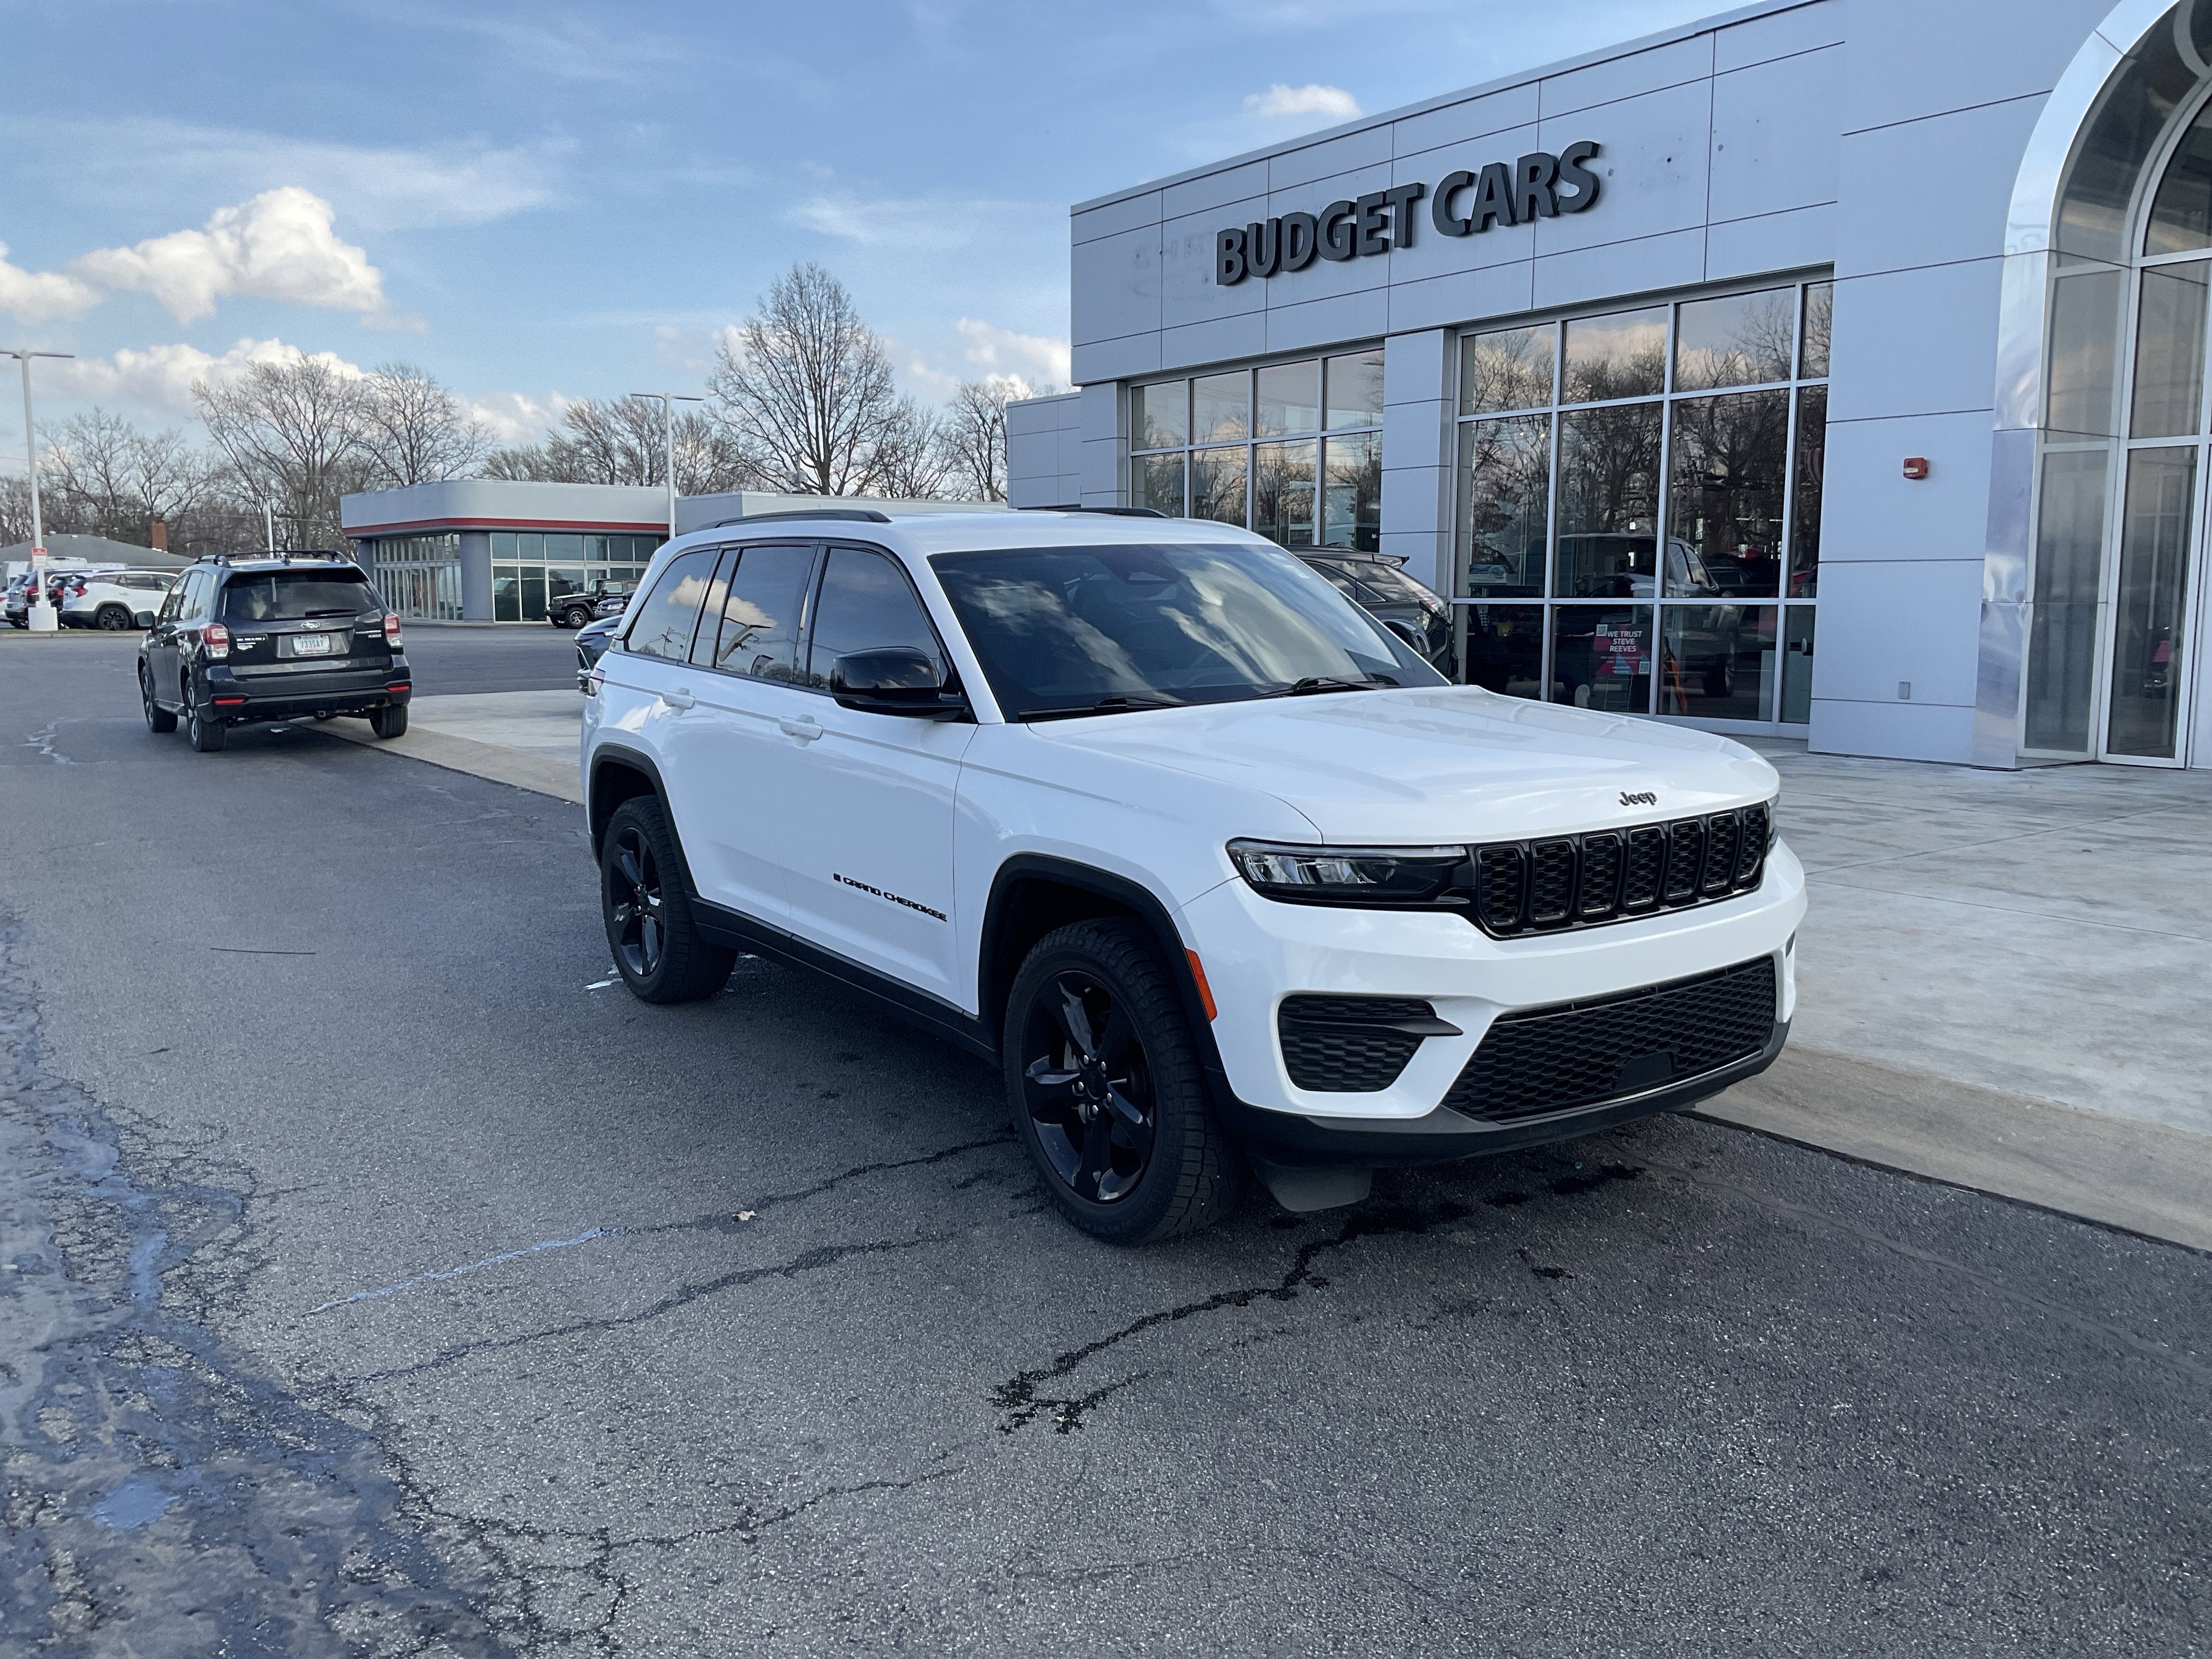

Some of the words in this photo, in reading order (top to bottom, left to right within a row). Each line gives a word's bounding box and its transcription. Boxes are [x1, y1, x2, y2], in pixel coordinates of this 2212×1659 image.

[1216, 183, 1425, 285] BUDGET
[1432, 140, 1600, 237] CARS
[1618, 791, 1657, 806] Jeep
[843, 877, 882, 896] GRAND
[883, 891, 947, 922] CHEROKEE
